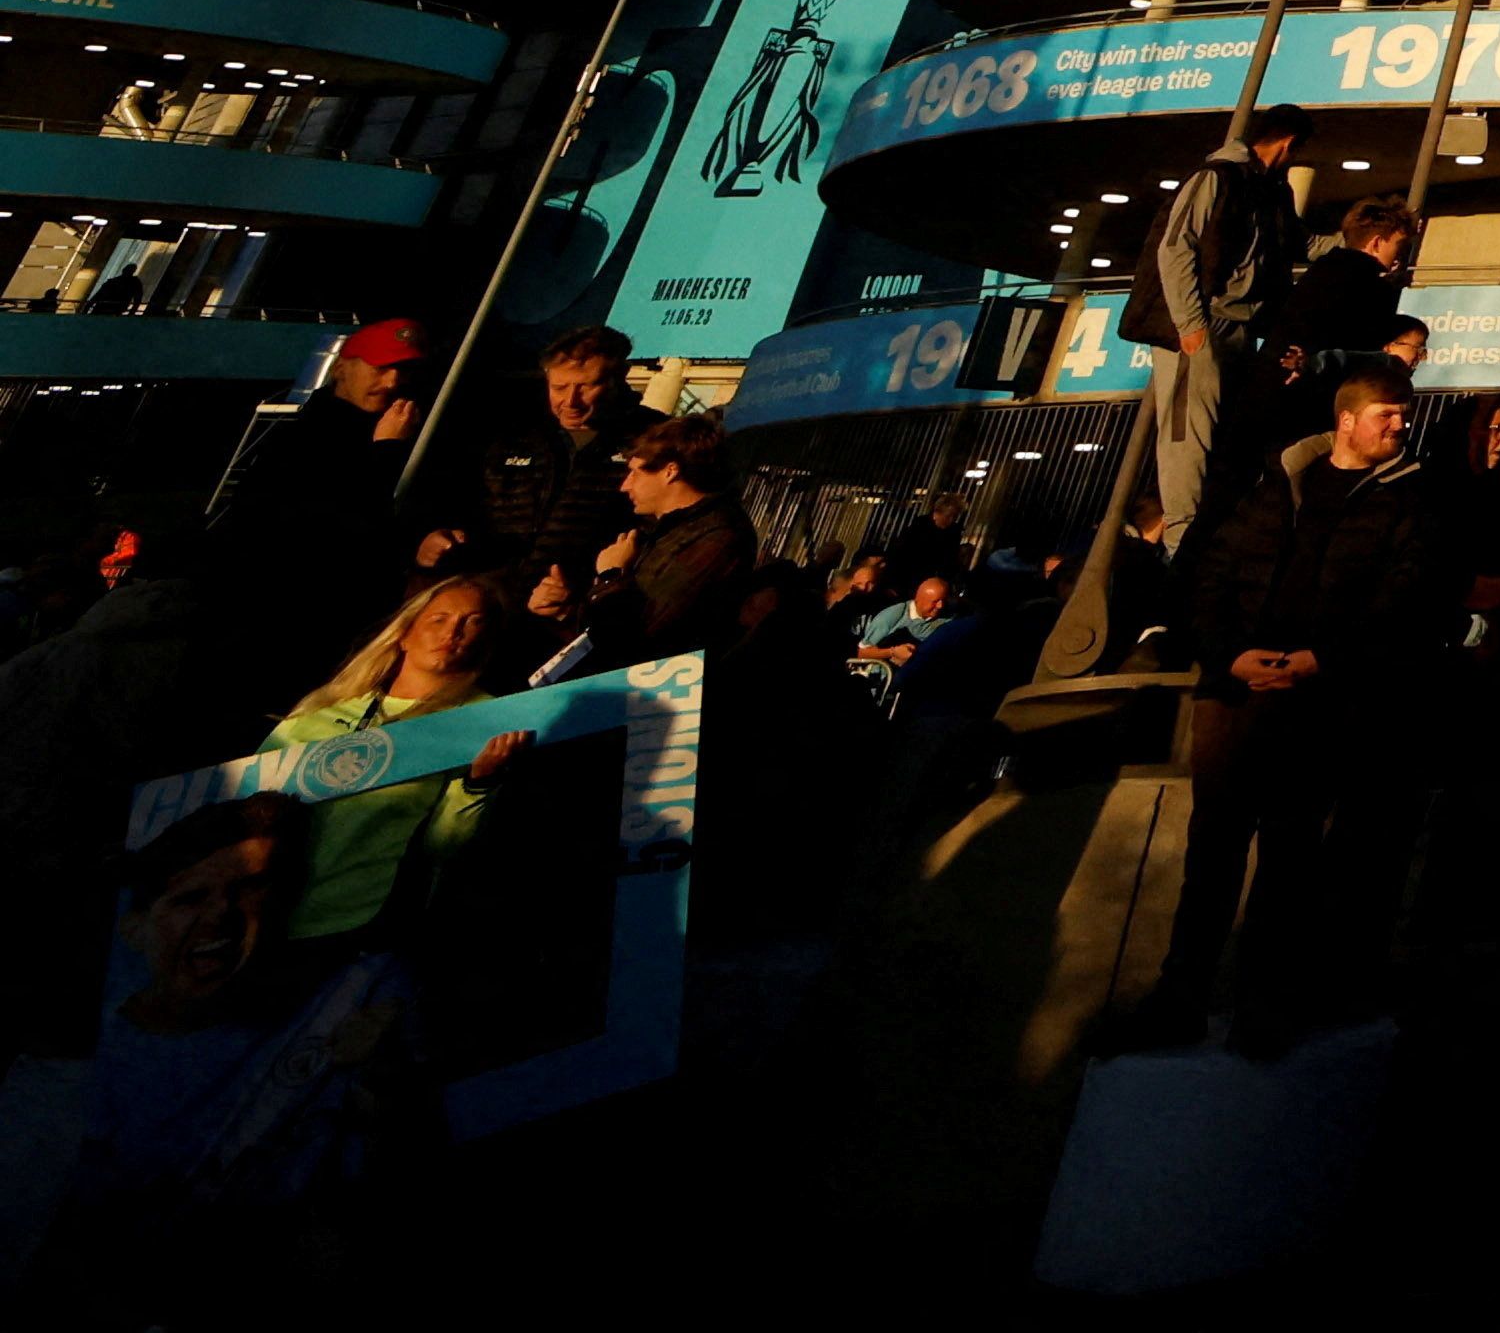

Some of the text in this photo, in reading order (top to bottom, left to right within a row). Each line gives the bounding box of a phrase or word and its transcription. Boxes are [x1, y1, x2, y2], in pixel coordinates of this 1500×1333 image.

[1055, 41, 1192, 75] City win their
[901, 48, 1039, 130] 1968
[1048, 67, 1213, 101] ever league title
[651, 277, 752, 302] MANCHESTER
[661, 308, 713, 326] 21.05.23
